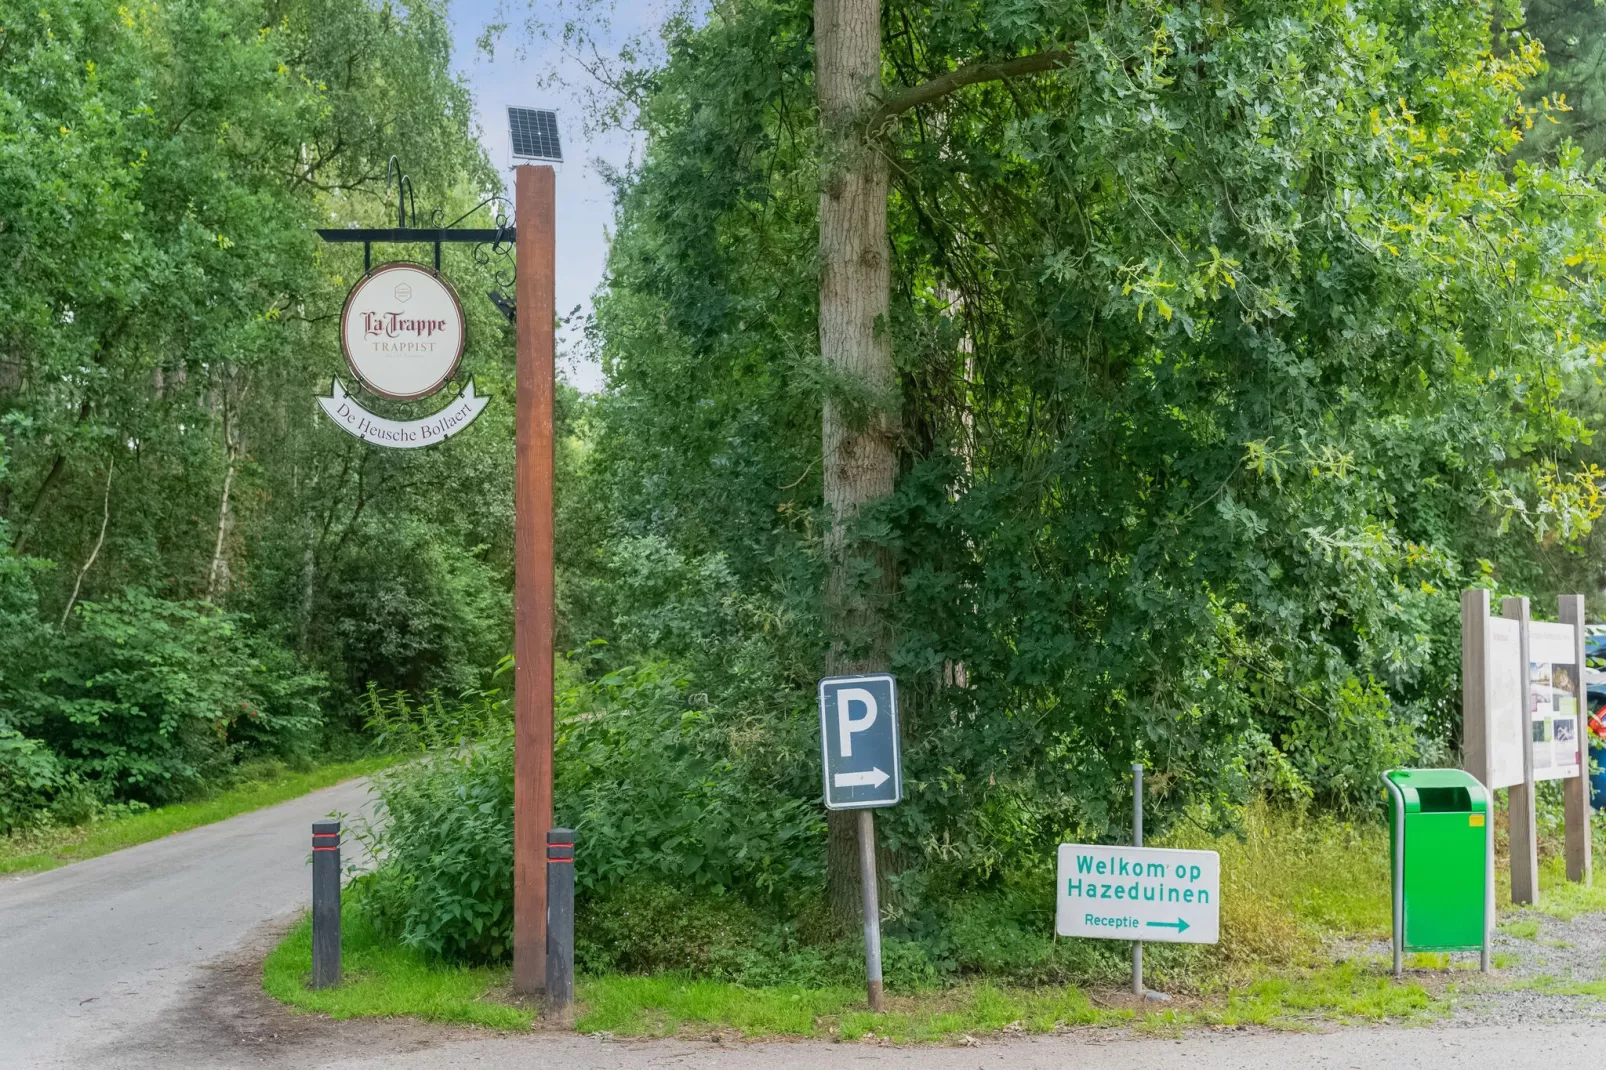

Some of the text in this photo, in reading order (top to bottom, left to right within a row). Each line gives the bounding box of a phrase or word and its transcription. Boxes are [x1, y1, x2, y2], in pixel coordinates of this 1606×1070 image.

[359, 310, 447, 341] La Trappe
[372, 342, 436, 352] TRAPPIST
[336, 402, 473, 442] De Heusche Bollaert
[837, 688, 878, 757] P
[1076, 855, 1201, 882] Welkom op
[1068, 878, 1209, 904] Hazeduinen
[1085, 914, 1139, 929] Receptie
